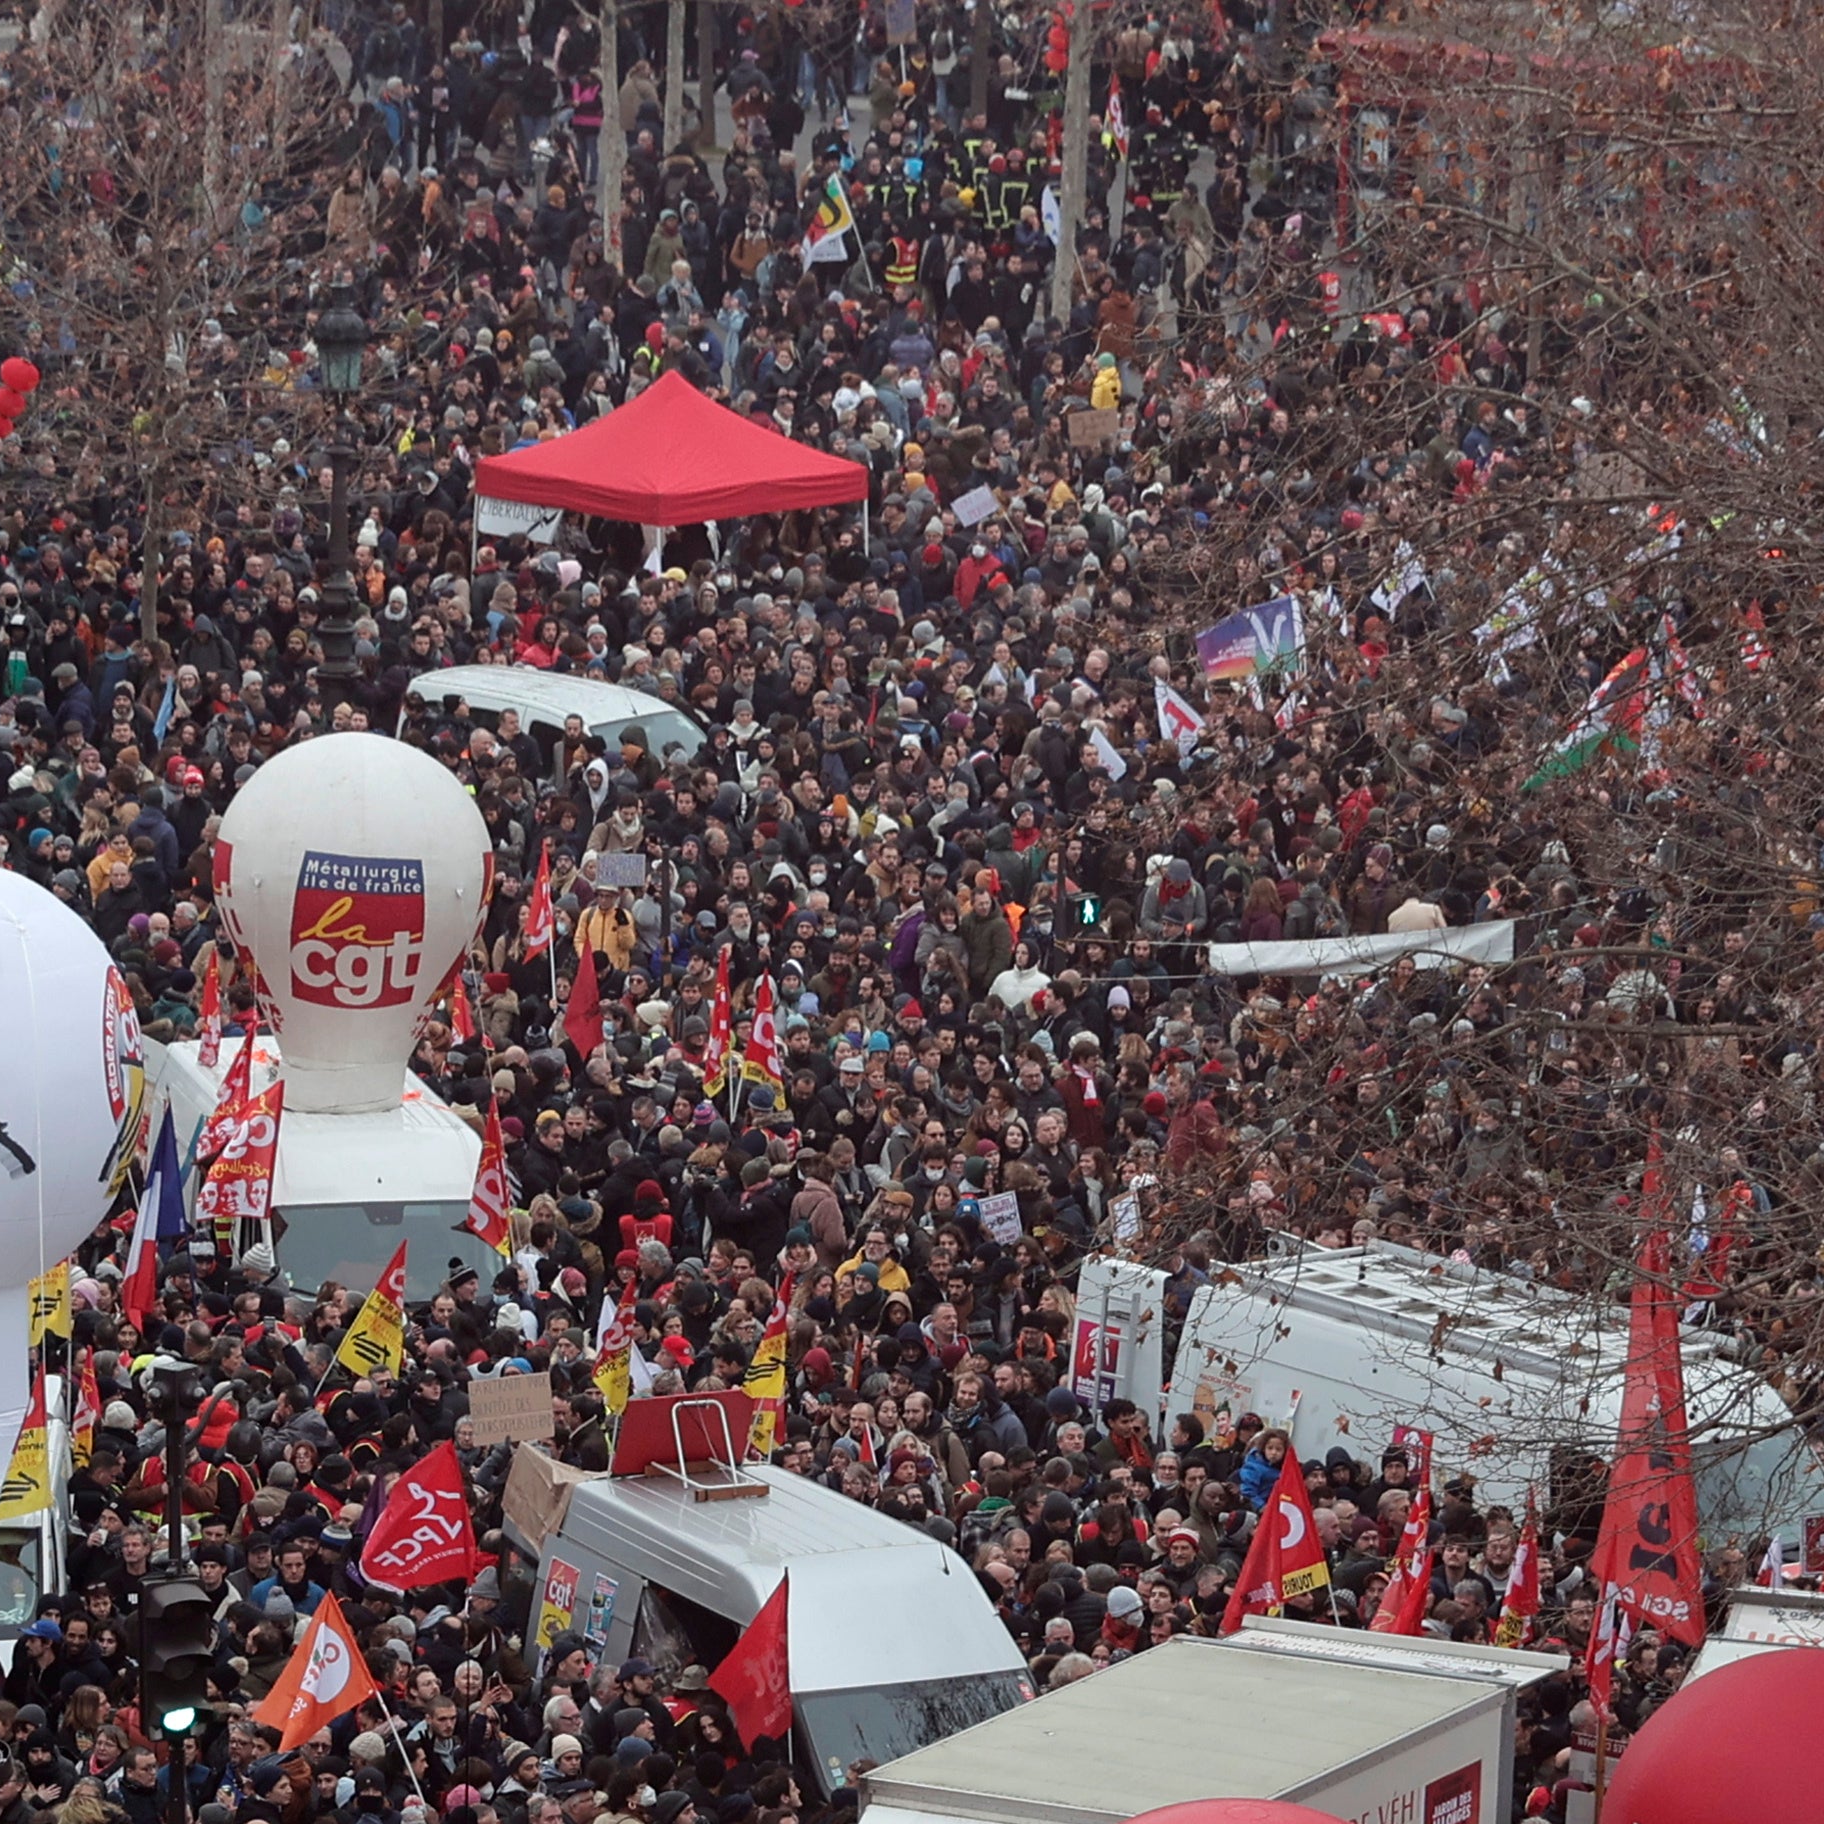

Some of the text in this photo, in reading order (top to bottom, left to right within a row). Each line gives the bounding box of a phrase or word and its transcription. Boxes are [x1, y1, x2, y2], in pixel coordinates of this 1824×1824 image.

[305, 857, 420, 880] Métallurgie
[302, 875, 422, 895] ile de france
[300, 896, 423, 946] la
[291, 930, 421, 1007] cgt
[547, 1582, 573, 1610] cgt
[1432, 1791, 1473, 1819] JARDIN DES
